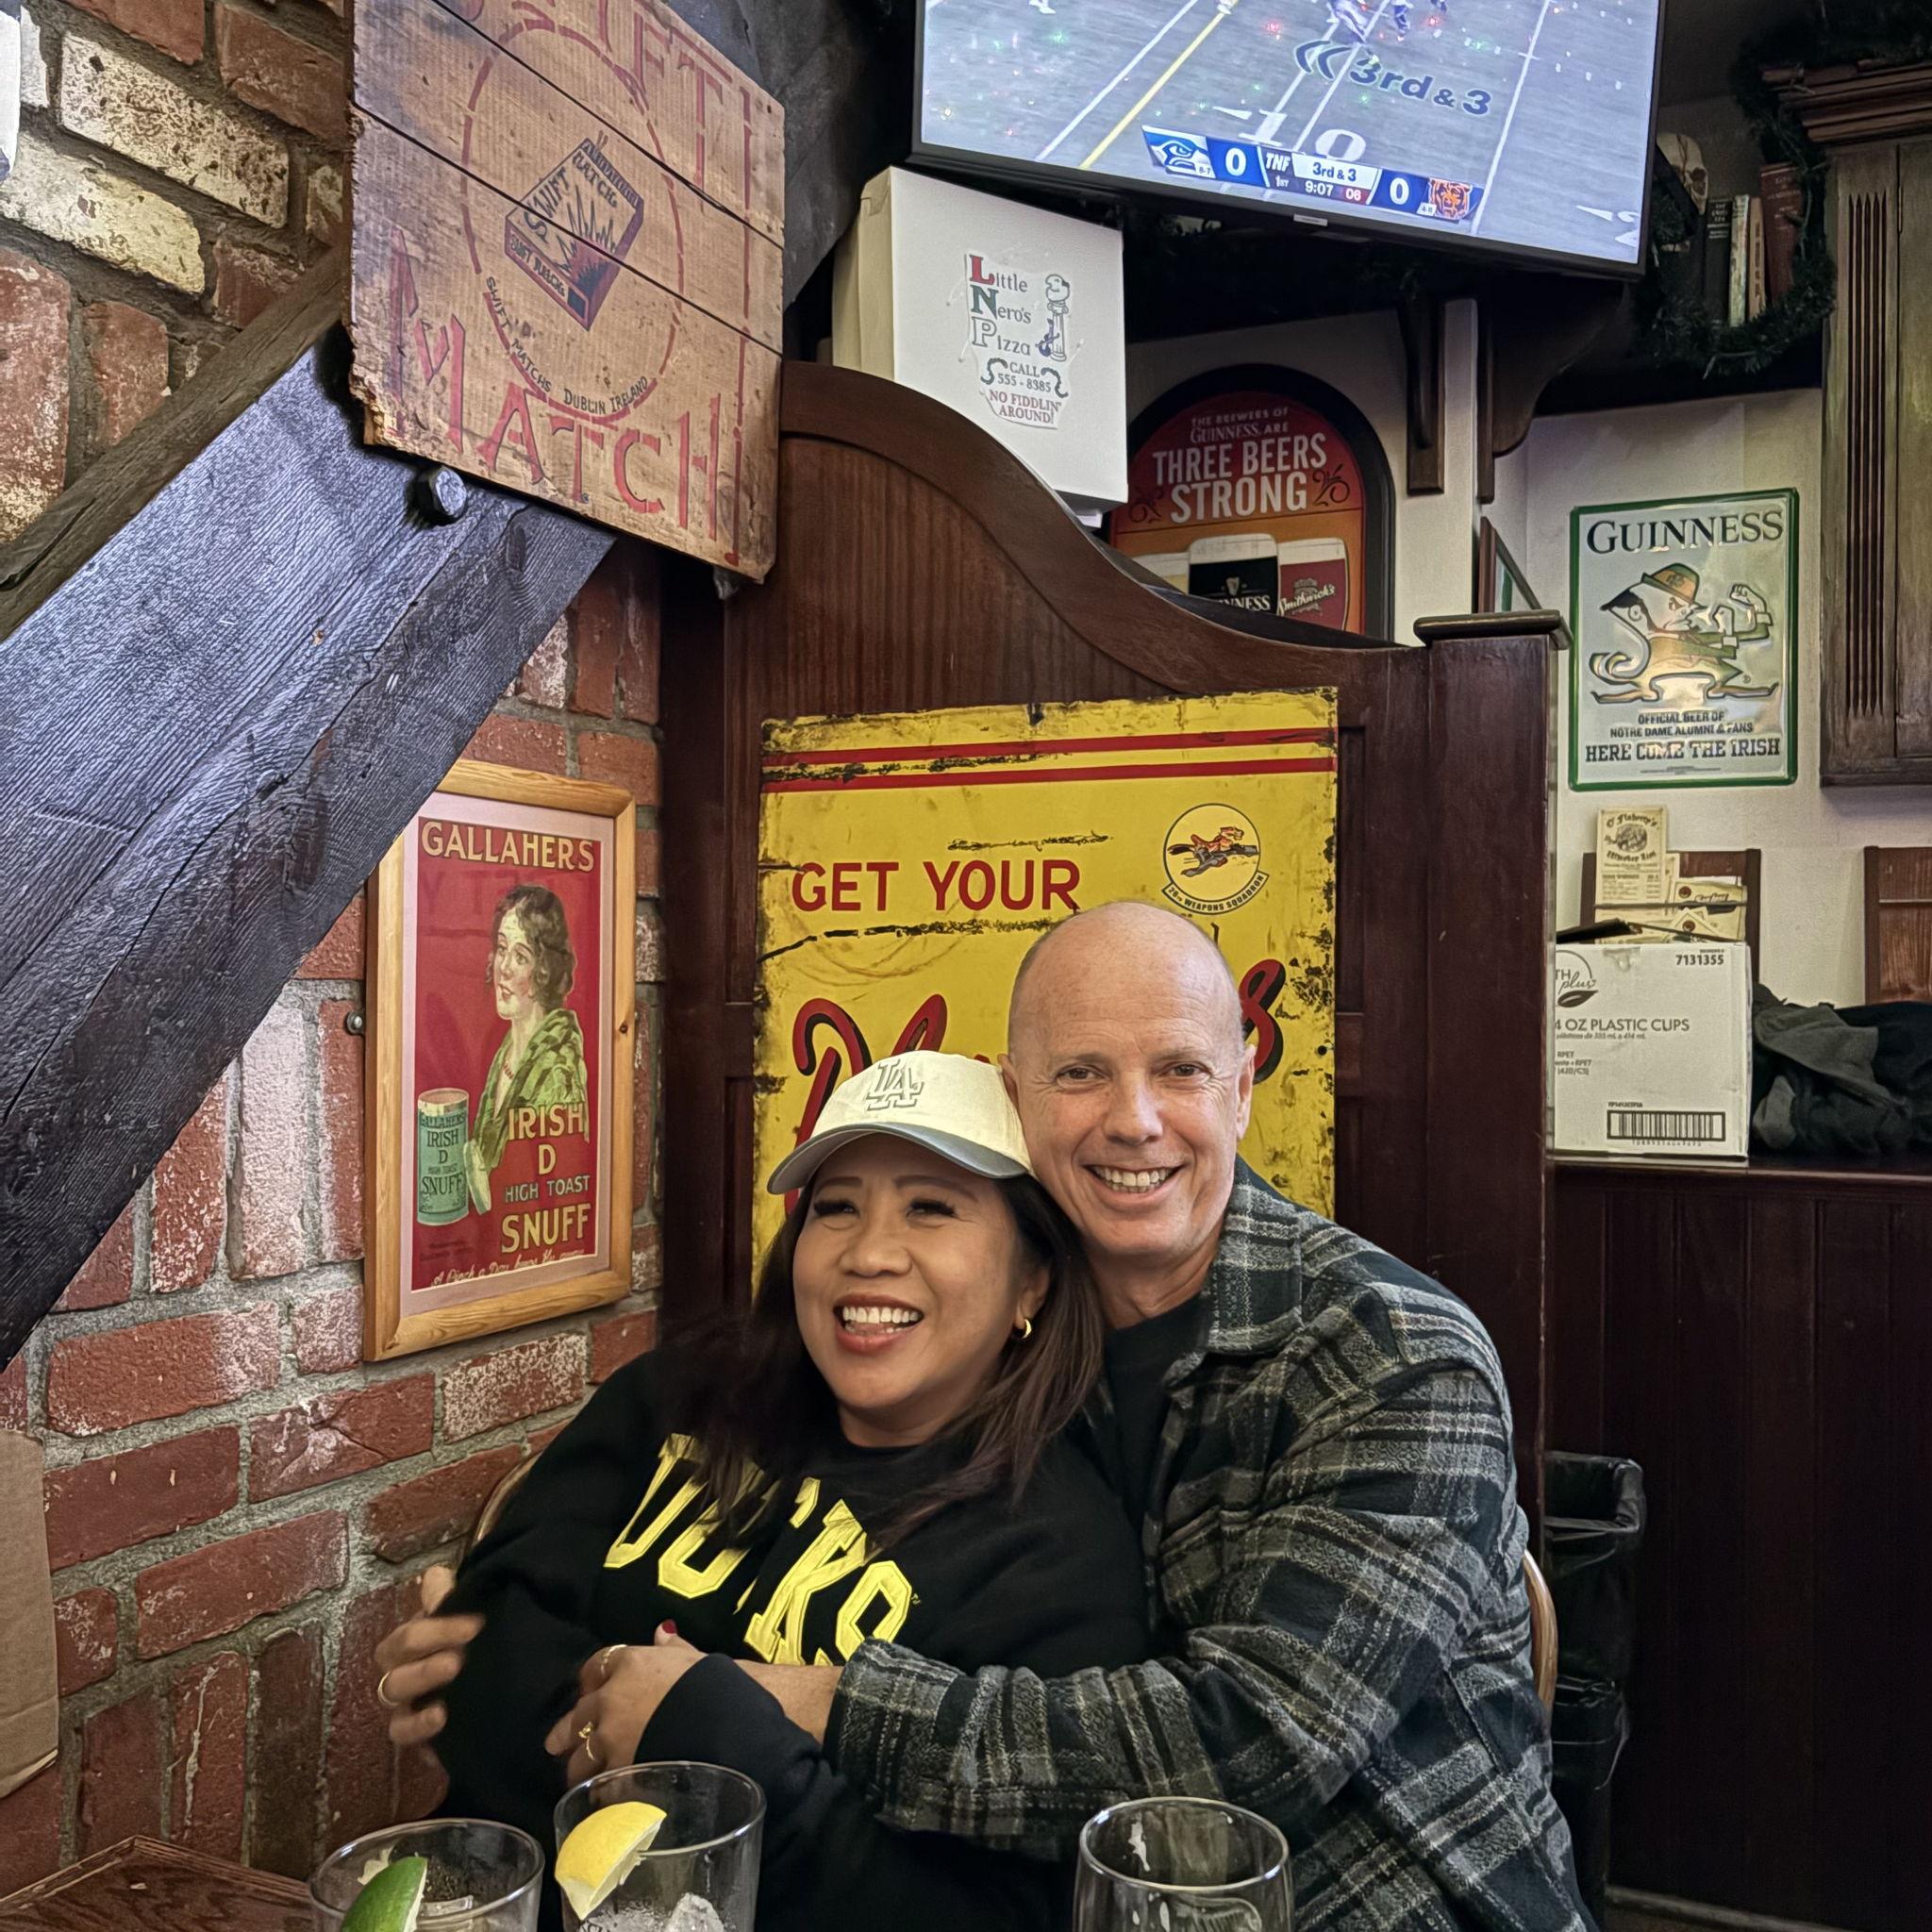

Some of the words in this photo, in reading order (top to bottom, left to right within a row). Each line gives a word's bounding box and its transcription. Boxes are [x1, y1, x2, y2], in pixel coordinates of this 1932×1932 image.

[1350, 57, 1433, 99] 3rd
[1434, 88, 1456, 108] &
[1463, 90, 1491, 114] 3
[1224, 147, 1247, 176] 0
[1266, 153, 1291, 172] TNF
[1312, 162, 1334, 178] 3rd
[1337, 170, 1345, 180] &
[1349, 170, 1357, 182] 3
[1305, 181, 1334, 197] 9:07
[1345, 189, 1361, 201] 06
[1390, 177, 1410, 206] 0
[970, 254, 1028, 294] Little
[970, 284, 1032, 325] Nero's
[486, 276, 512, 329] SWIFT
[511, 338, 553, 392] MATCHS
[563, 387, 607, 415] DUBLIN
[609, 375, 649, 412] IRELAND
[971, 315, 1031, 357] Pizza
[1009, 361, 1041, 378] CALL
[989, 390, 1008, 404] NO
[998, 405, 1055, 425] AROUND!
[1191, 423, 1261, 444] GUINNESS
[1152, 442, 1232, 487] THREE
[1242, 432, 1327, 476] BEERS
[1170, 471, 1307, 524] STRONG
[1586, 510, 1784, 554] GUINNESS
[1609, 726, 1643, 739] NOTRE
[1644, 725, 1674, 737] DAME
[1674, 724, 1715, 736] ALUMNI
[1726, 722, 1754, 734] FANS
[1638, 712, 1679, 725] OFFICIAL
[1681, 711, 1710, 724] BEER
[1711, 710, 1725, 723] OF
[1585, 744, 1632, 763] HERE
[1636, 741, 1685, 760] COME
[1690, 740, 1726, 758] THE
[1731, 738, 1781, 758] IRISH
[421, 821, 595, 873] GALLAHERS
[791, 862, 899, 912] GET
[924, 858, 1082, 915] YOUR
[1184, 898, 1224, 911] WEAPONS
[1226, 874, 1264, 908] SQUADRON
[1675, 954, 1724, 966] 7131355
[1557, 971, 1597, 995] plus
[1565, 1019, 1588, 1032] OZ
[1591, 1019, 1648, 1032] PLASTIC
[1651, 1019, 1690, 1032] CUPS
[865, 1058, 925, 1111] LA
[508, 1102, 584, 1141] IRISH
[426, 1128, 459, 1148] IRISH
[439, 1149, 448, 1164] D
[538, 1143, 557, 1175] D
[422, 1172, 464, 1196] SNUFF
[505, 1182, 540, 1204] HIGH
[546, 1175, 591, 1197] TOAST
[500, 1203, 591, 1254] SNUFF
